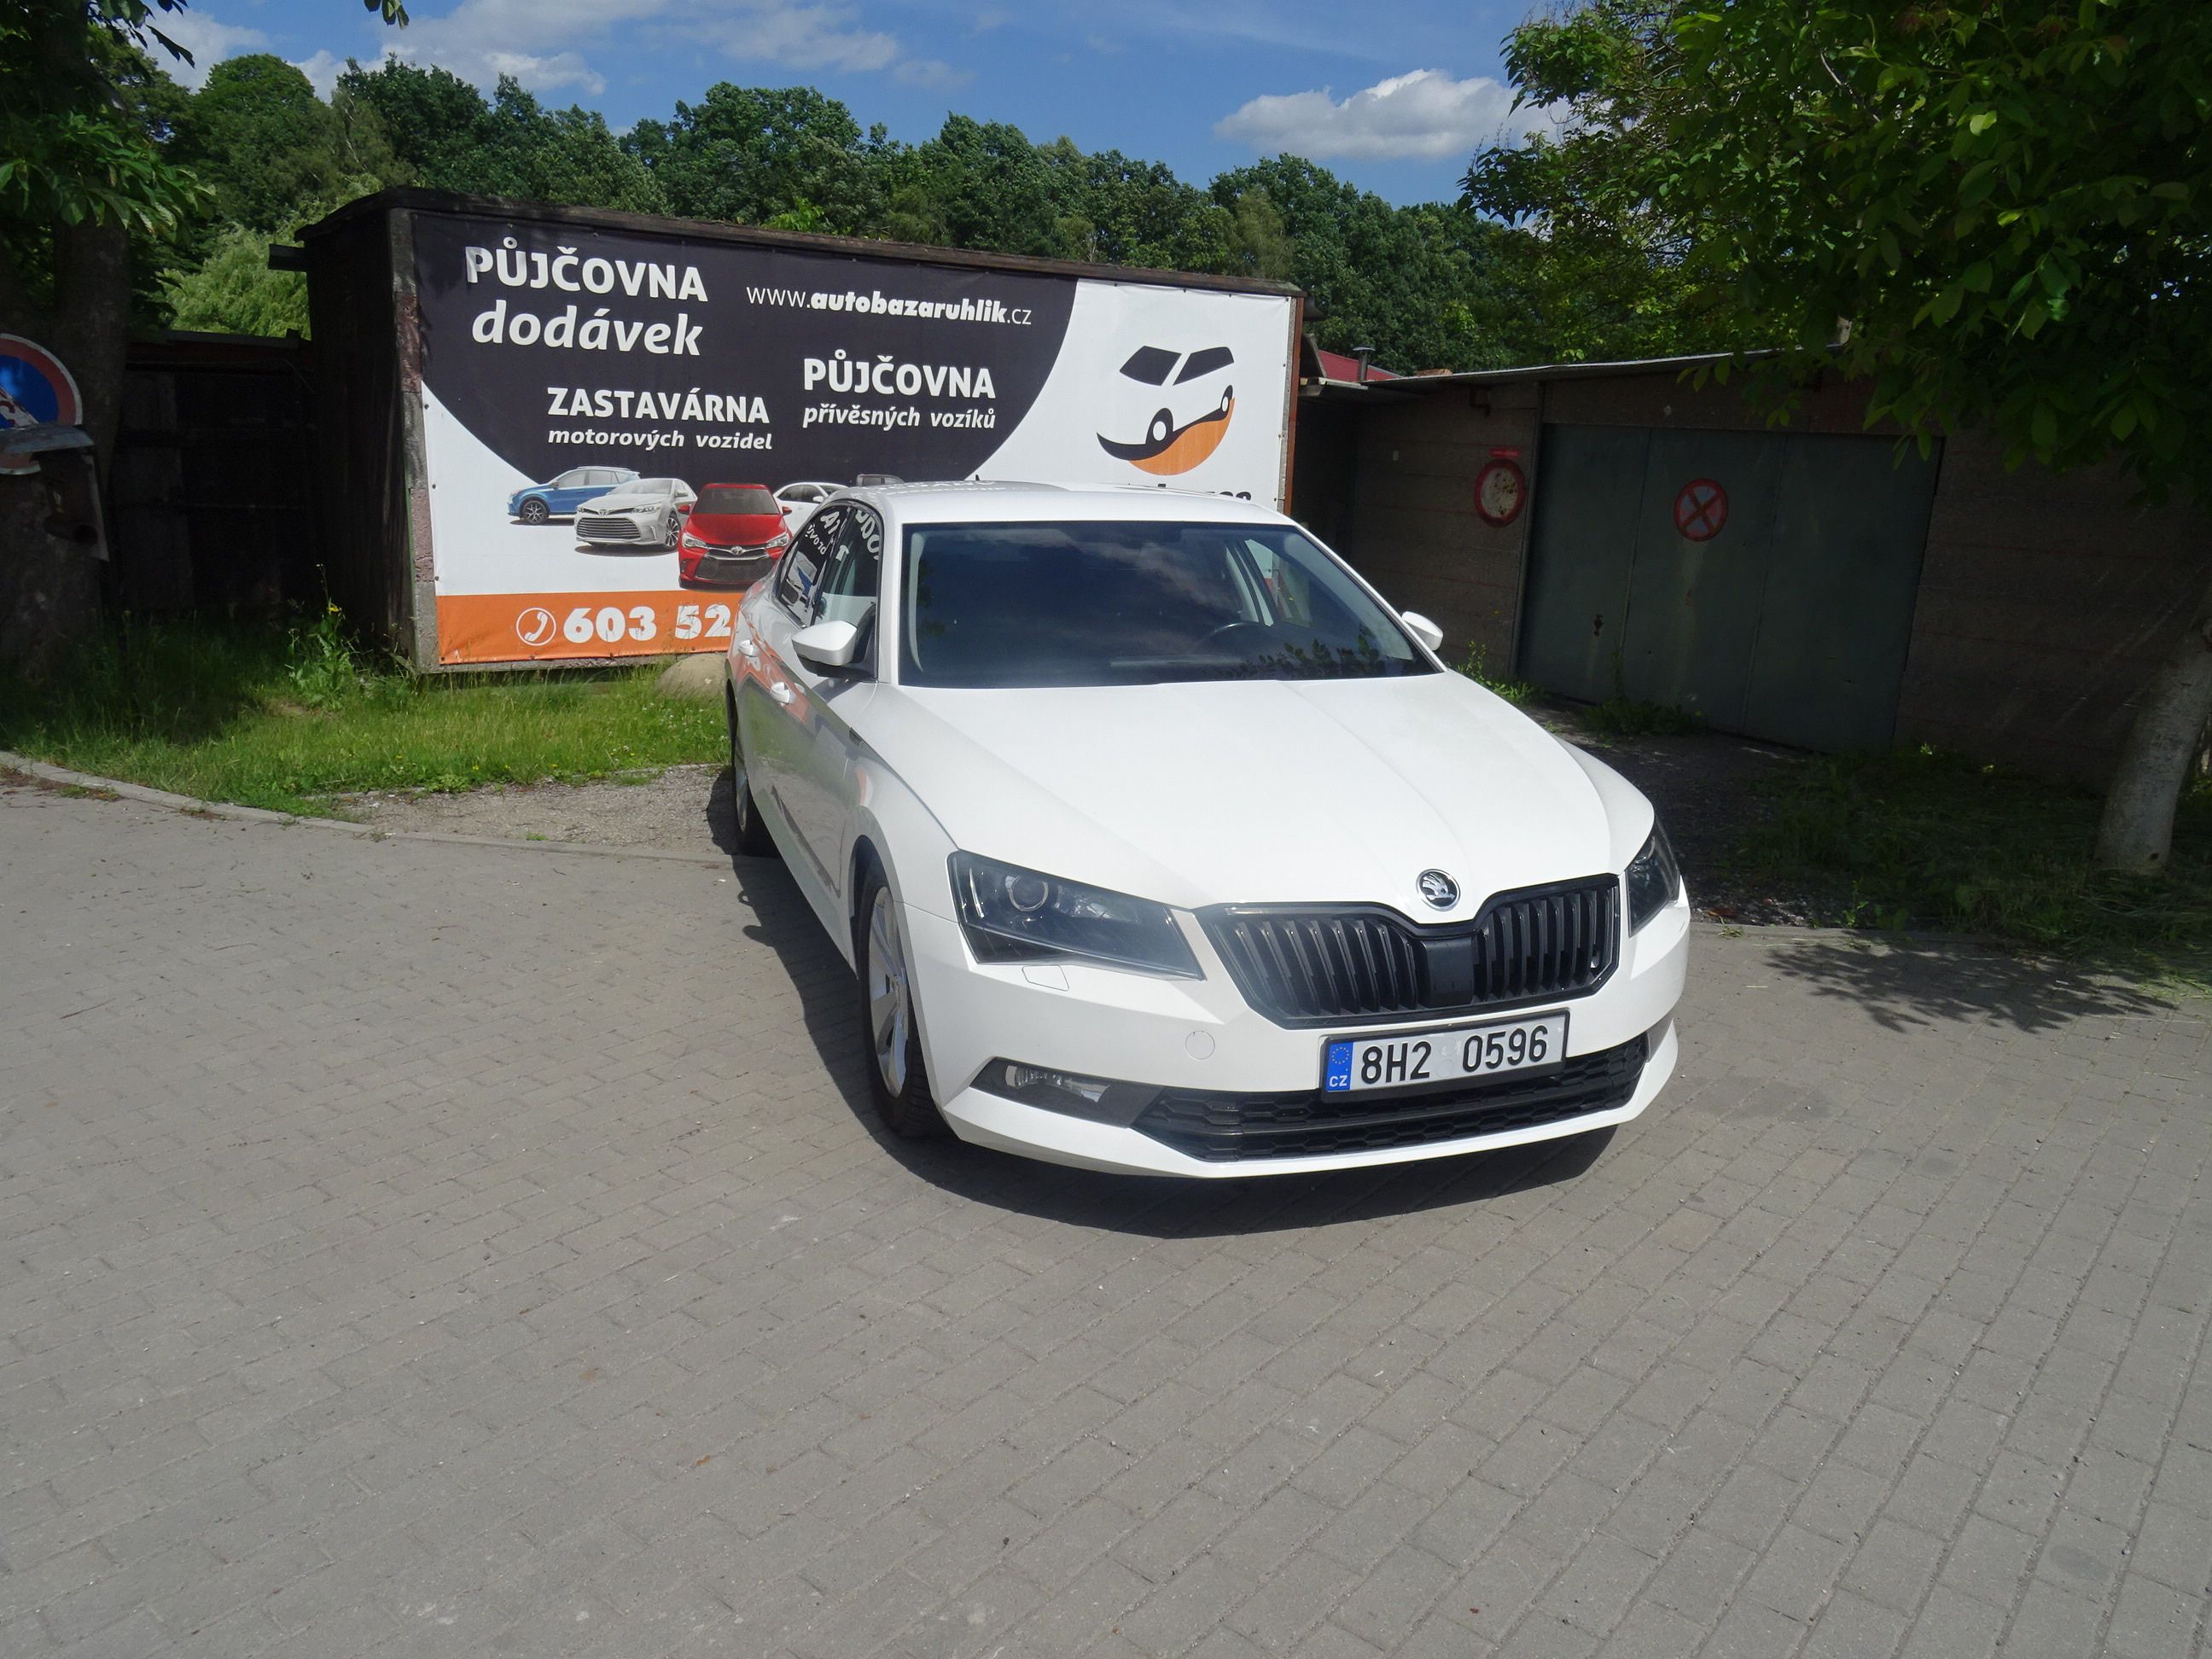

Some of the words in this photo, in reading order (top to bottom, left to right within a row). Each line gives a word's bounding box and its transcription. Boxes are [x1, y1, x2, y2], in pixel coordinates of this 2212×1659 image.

[465, 236, 708, 302] PŮJČOVNA
[746, 286, 1032, 325] www.autobazaruhlik.cz
[471, 299, 703, 356] dodávek
[803, 348, 996, 399] PŮJČOVNA
[547, 387, 771, 424] ZASTAVÁRNA
[802, 403, 921, 432] přívěsných
[930, 407, 996, 429] vozíků
[548, 428, 684, 451] motorových
[696, 432, 772, 451] vozidel
[562, 605, 657, 643] 603
[1329, 1074, 1348, 1088] CZ
[1360, 1039, 1433, 1086] 8H2
[1461, 1025, 1548, 1074] 0596
